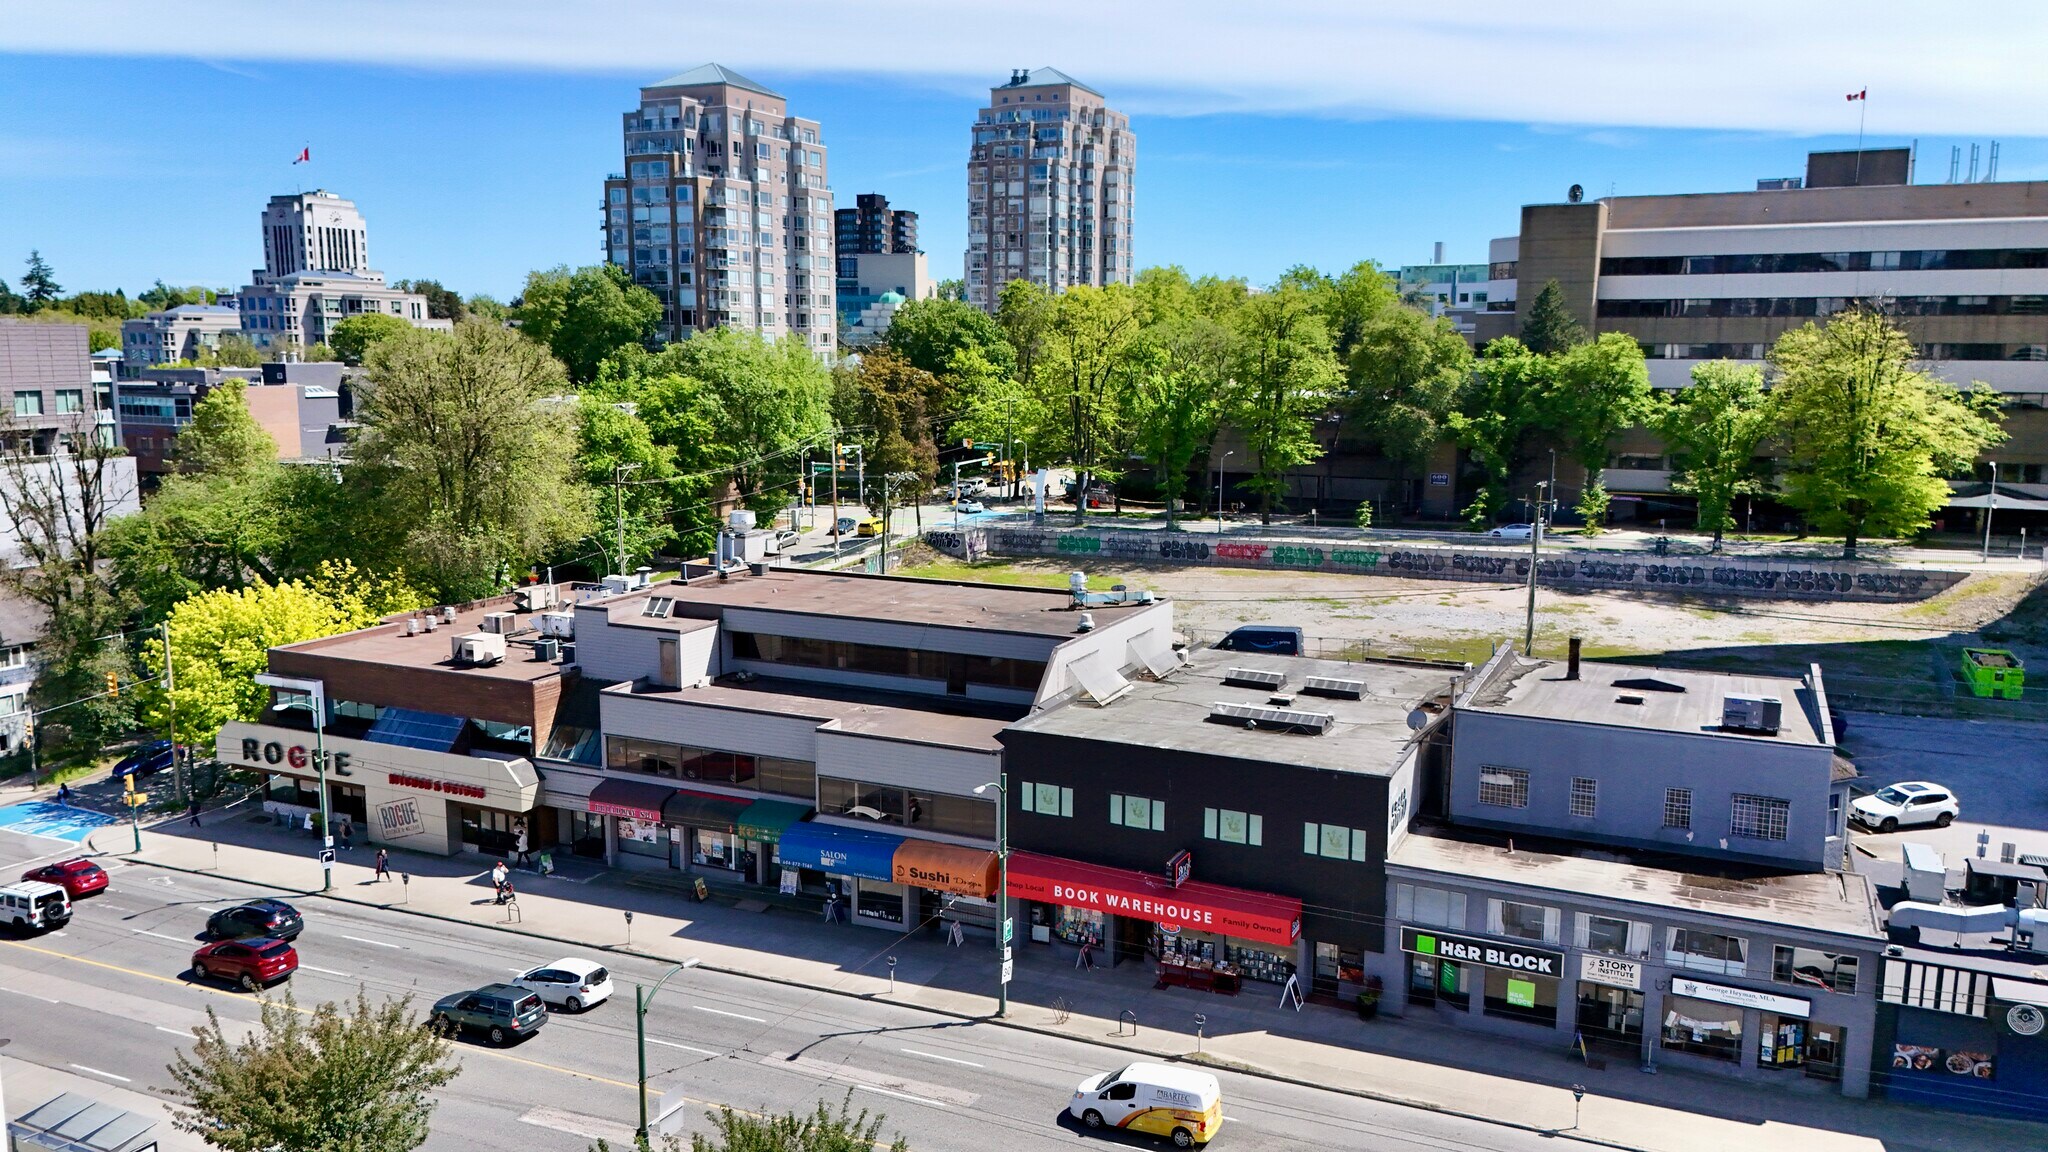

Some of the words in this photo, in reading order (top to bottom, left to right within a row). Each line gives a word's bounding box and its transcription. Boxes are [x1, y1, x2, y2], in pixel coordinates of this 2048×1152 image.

[242, 738, 352, 776] ROGUE
[380, 801, 418, 829] ROGUE
[820, 849, 847, 861] SALON
[909, 867, 950, 884] Sushi
[1025, 883, 1045, 892] Local
[1054, 885, 1099, 904] BOOK
[1105, 893, 1213, 924] WAREHOUSE
[1222, 917, 1250, 929] Family
[1252, 922, 1282, 934] Owned
[1440, 941, 1481, 960] H&R
[1485, 948, 1552, 973] BLOCK
[1598, 959, 1634, 972] STORY
[1597, 968, 1634, 979] INSTITUTE
[1705, 985, 1728, 994] George
[1163, 1090, 1190, 1102] BARTEC
